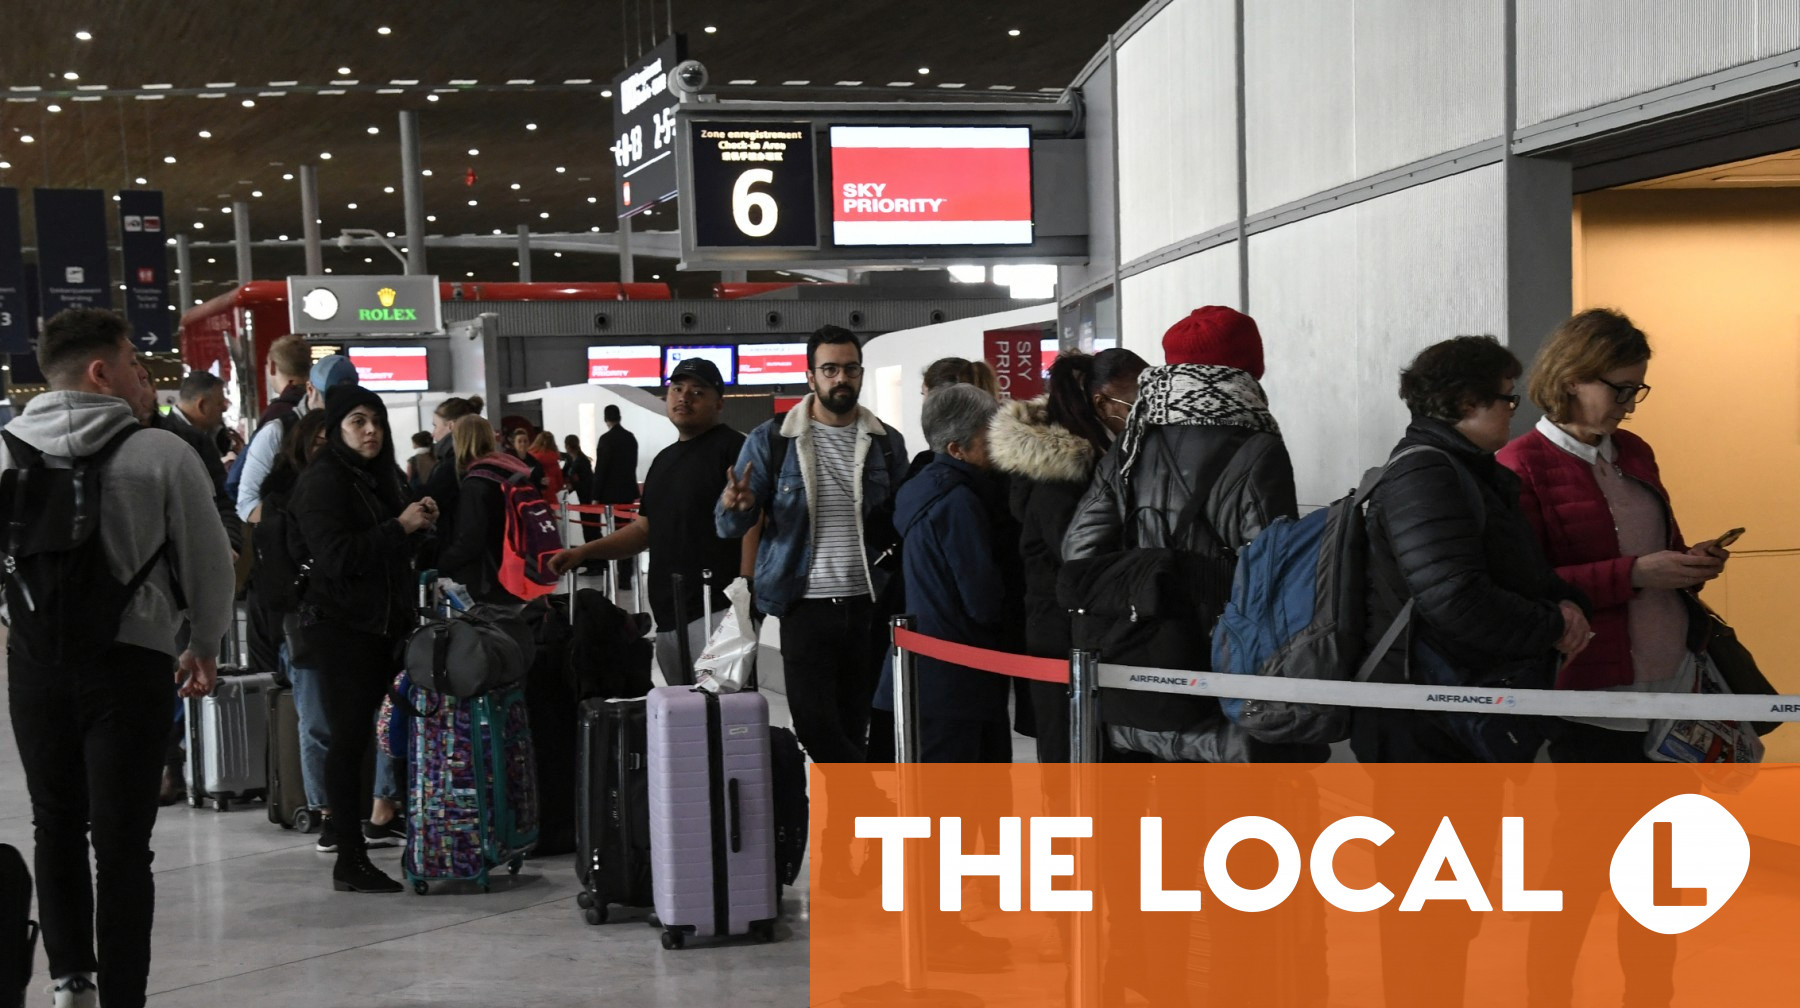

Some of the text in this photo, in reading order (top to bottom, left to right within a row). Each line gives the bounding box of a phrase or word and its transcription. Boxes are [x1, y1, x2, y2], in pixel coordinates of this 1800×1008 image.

[700, 129, 803, 141] Zone enregistrement
[718, 140, 787, 150] Check-in Area
[843, 182, 887, 198] SKY
[732, 168, 779, 237] 6
[843, 198, 944, 213] PRIORITY
[359, 308, 417, 321] ROLEX
[1016, 341, 1032, 381] SKY
[1129, 674, 1188, 686] AIRFRANCE
[1426, 693, 1493, 705] AIRFRANCE
